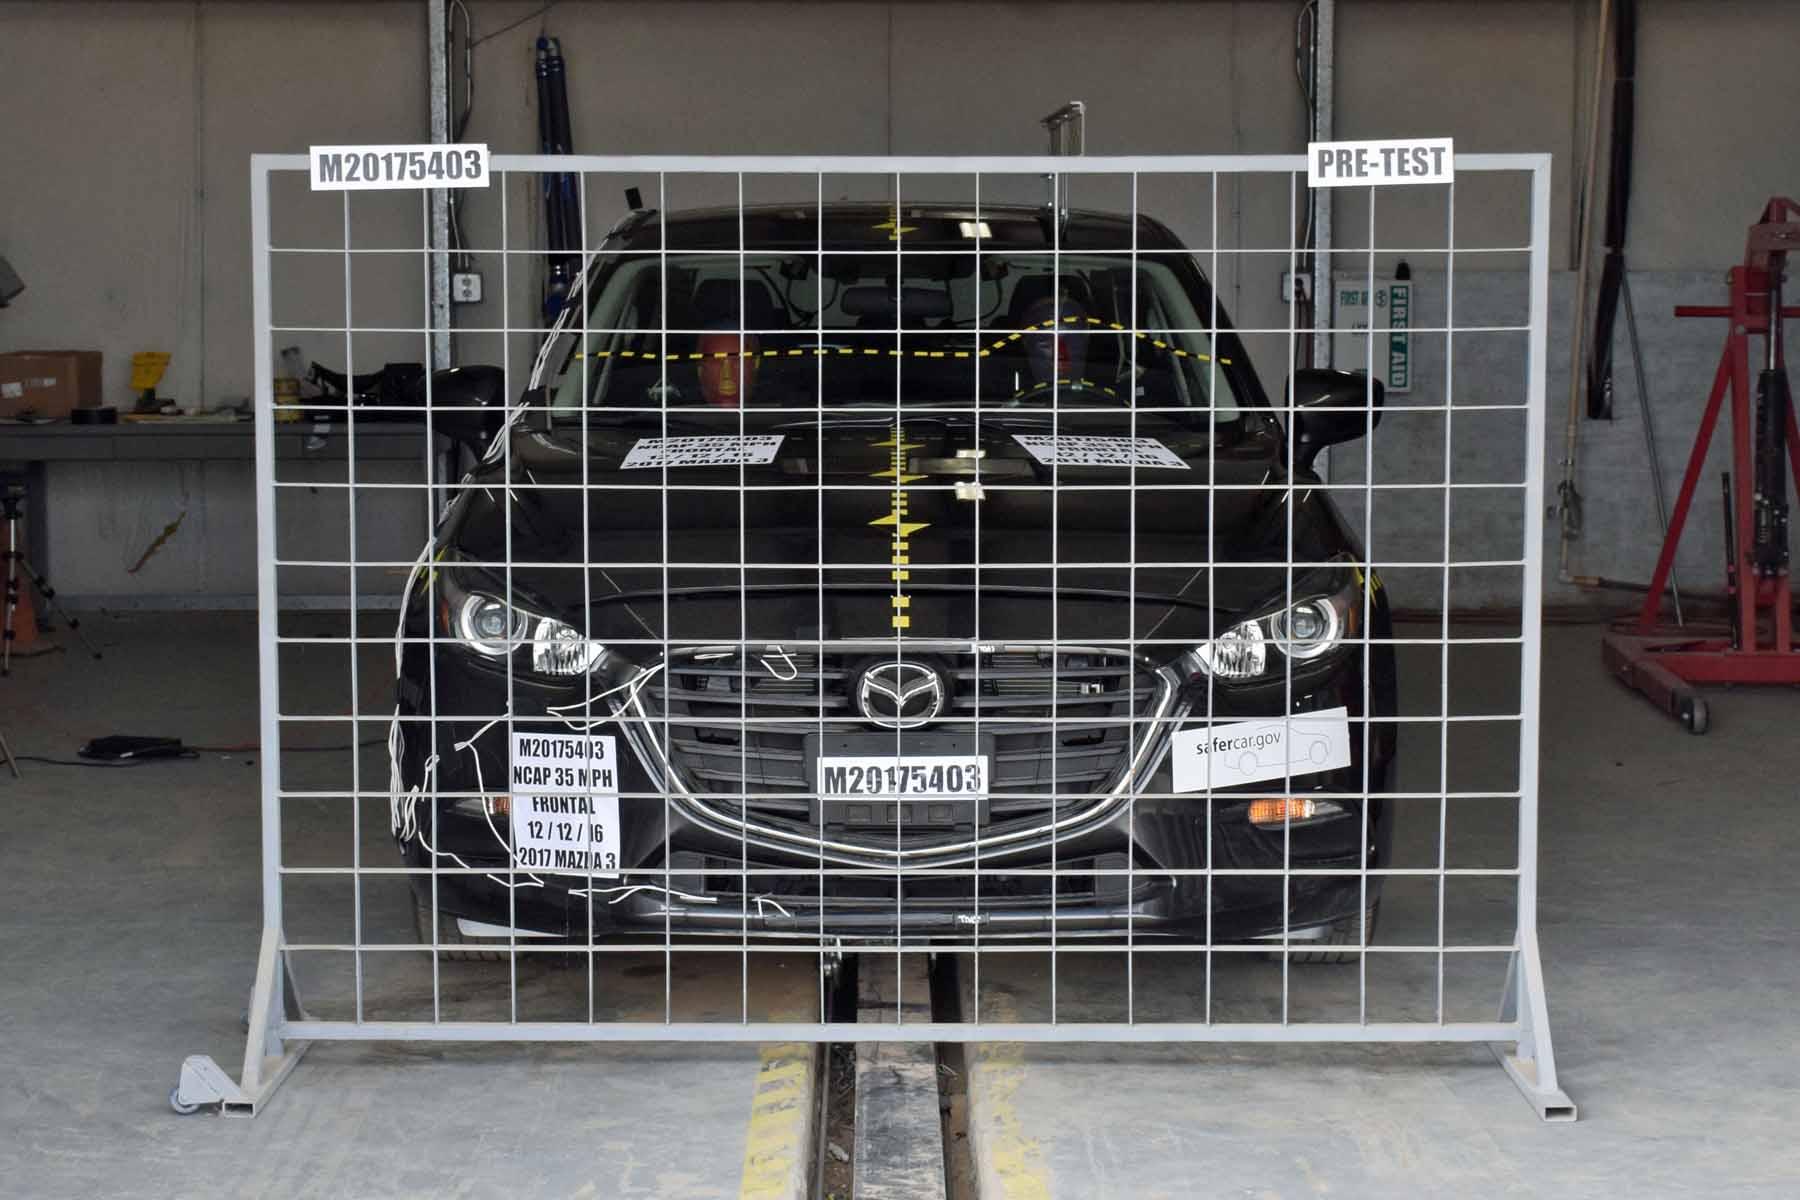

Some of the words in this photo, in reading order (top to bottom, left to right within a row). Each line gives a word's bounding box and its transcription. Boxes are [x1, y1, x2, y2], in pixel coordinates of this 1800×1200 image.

[319, 150, 482, 182] M20175403
[1318, 147, 1446, 178] PRE-TEST
[1392, 287, 1408, 345] FIRST
[1391, 351, 1407, 386] AID
[520, 738, 604, 759] M20175403
[1196, 732, 1281, 755] safercar.gov
[513, 766, 551, 785] NCAP
[555, 767, 574, 786] 35
[824, 764, 981, 794] M20175403
[532, 796, 596, 814] FRONTAL
[519, 847, 551, 867] 2017
[605, 852, 616, 869] 3
